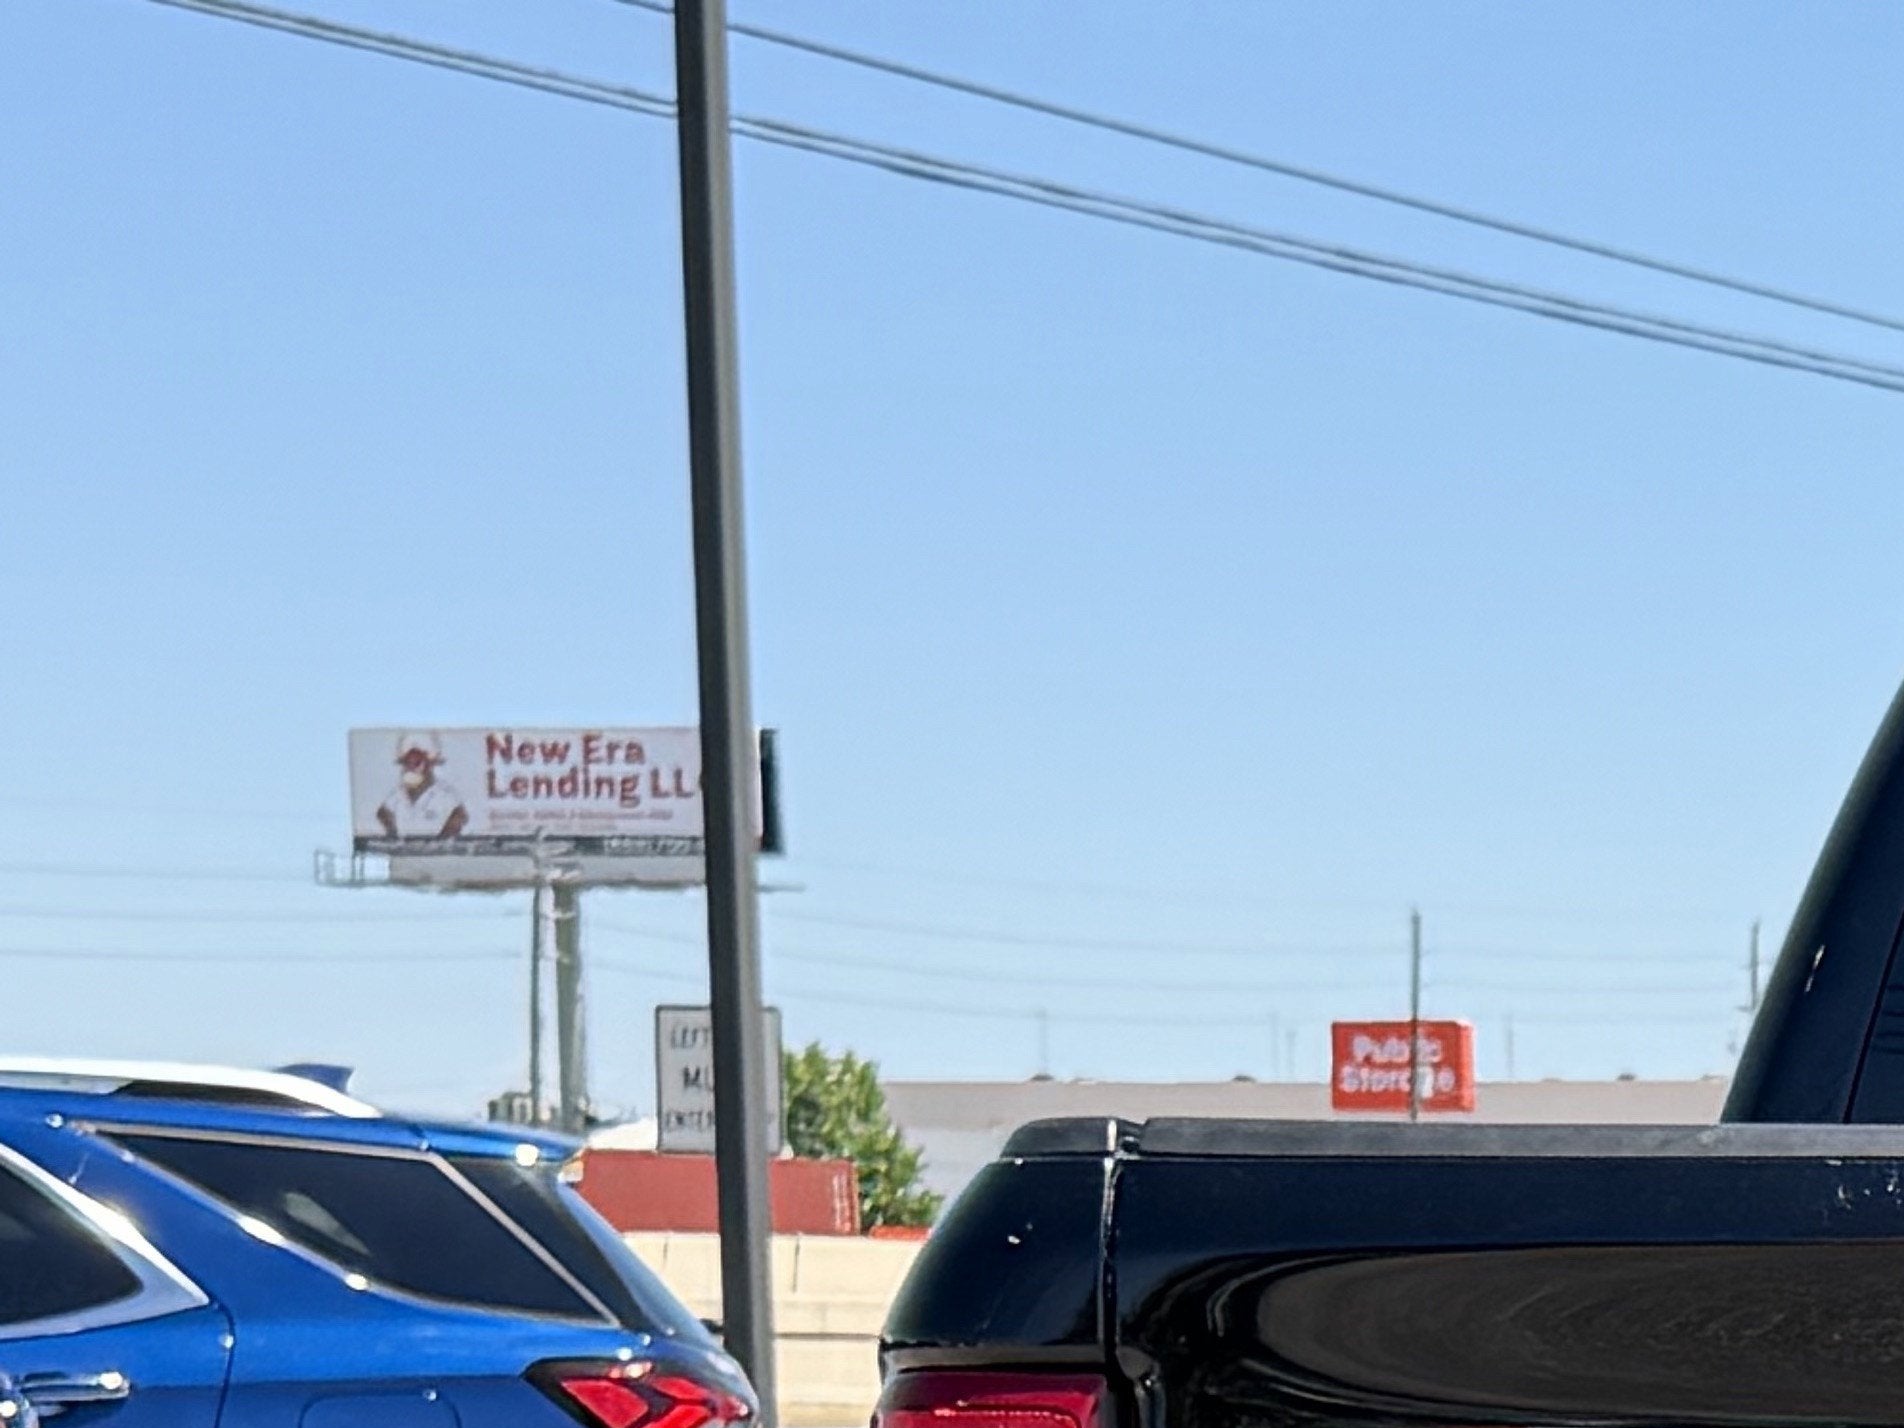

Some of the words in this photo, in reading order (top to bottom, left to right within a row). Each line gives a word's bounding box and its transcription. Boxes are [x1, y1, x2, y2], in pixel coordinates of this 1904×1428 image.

[486, 732, 571, 765] New
[582, 730, 646, 765] Era
[486, 766, 642, 809] Lending
[651, 766, 700, 799] LL
